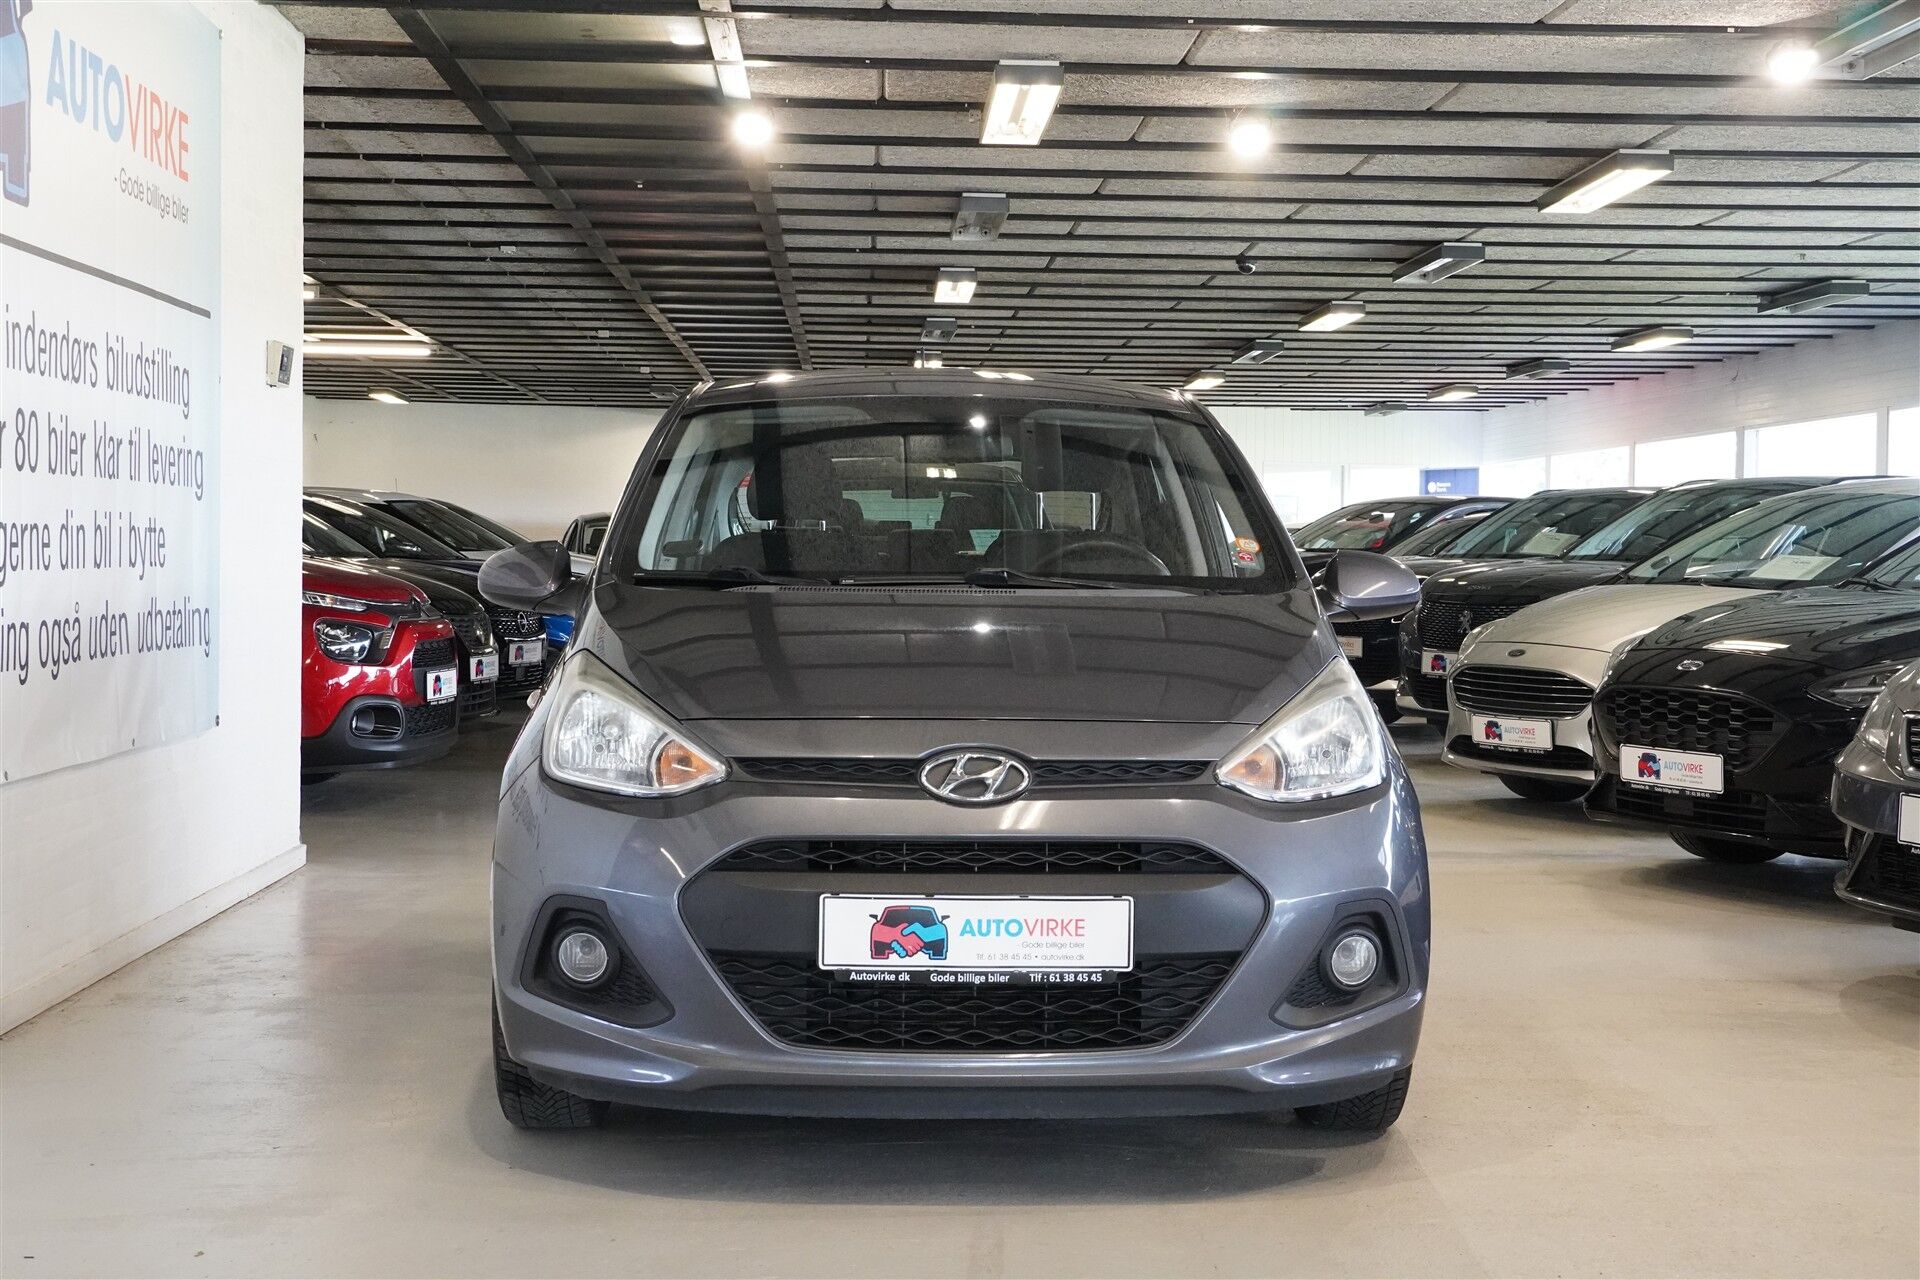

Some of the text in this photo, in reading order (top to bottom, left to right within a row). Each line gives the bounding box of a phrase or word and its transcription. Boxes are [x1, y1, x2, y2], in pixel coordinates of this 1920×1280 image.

[46, 29, 189, 183] AUTOVIRKE
[119, 167, 145, 202] Gode
[146, 180, 171, 219] billige
[172, 193, 189, 224] biler
[5, 303, 190, 420] indendørs biludstilling
[14, 407, 39, 473] 80
[47, 411, 87, 477] biler
[93, 419, 123, 480] klar
[128, 426, 141, 482] til
[147, 428, 204, 501] levering
[0, 508, 166, 588] gerne din bil i bytte
[38, 601, 81, 680] også
[88, 599, 130, 660] uden
[137, 595, 211, 658] udbetaling
[1663, 760, 1704, 774] AUTOVIRKE
[959, 918, 1086, 938] AUTOVIRKE
[987, 952, 997, 961] 61
[999, 952, 1009, 961] 38
[1010, 953, 1020, 961] 45
[1022, 953, 1032, 961] 45
[1040, 952, 1085, 961] autovirke.dk
[1021, 941, 1085, 950] Gode billige biler
[849, 971, 896, 982] Autovirke
[898, 971, 911, 982] dk
[929, 972, 956, 983] Gode
[957, 972, 986, 985] billige
[987, 972, 1010, 983] biler
[1029, 973, 1043, 983] Tlf
[1049, 973, 1061, 983] 61
[1063, 973, 1075, 983] 38
[1077, 973, 1089, 983] 45
[1090, 973, 1103, 983] 45
